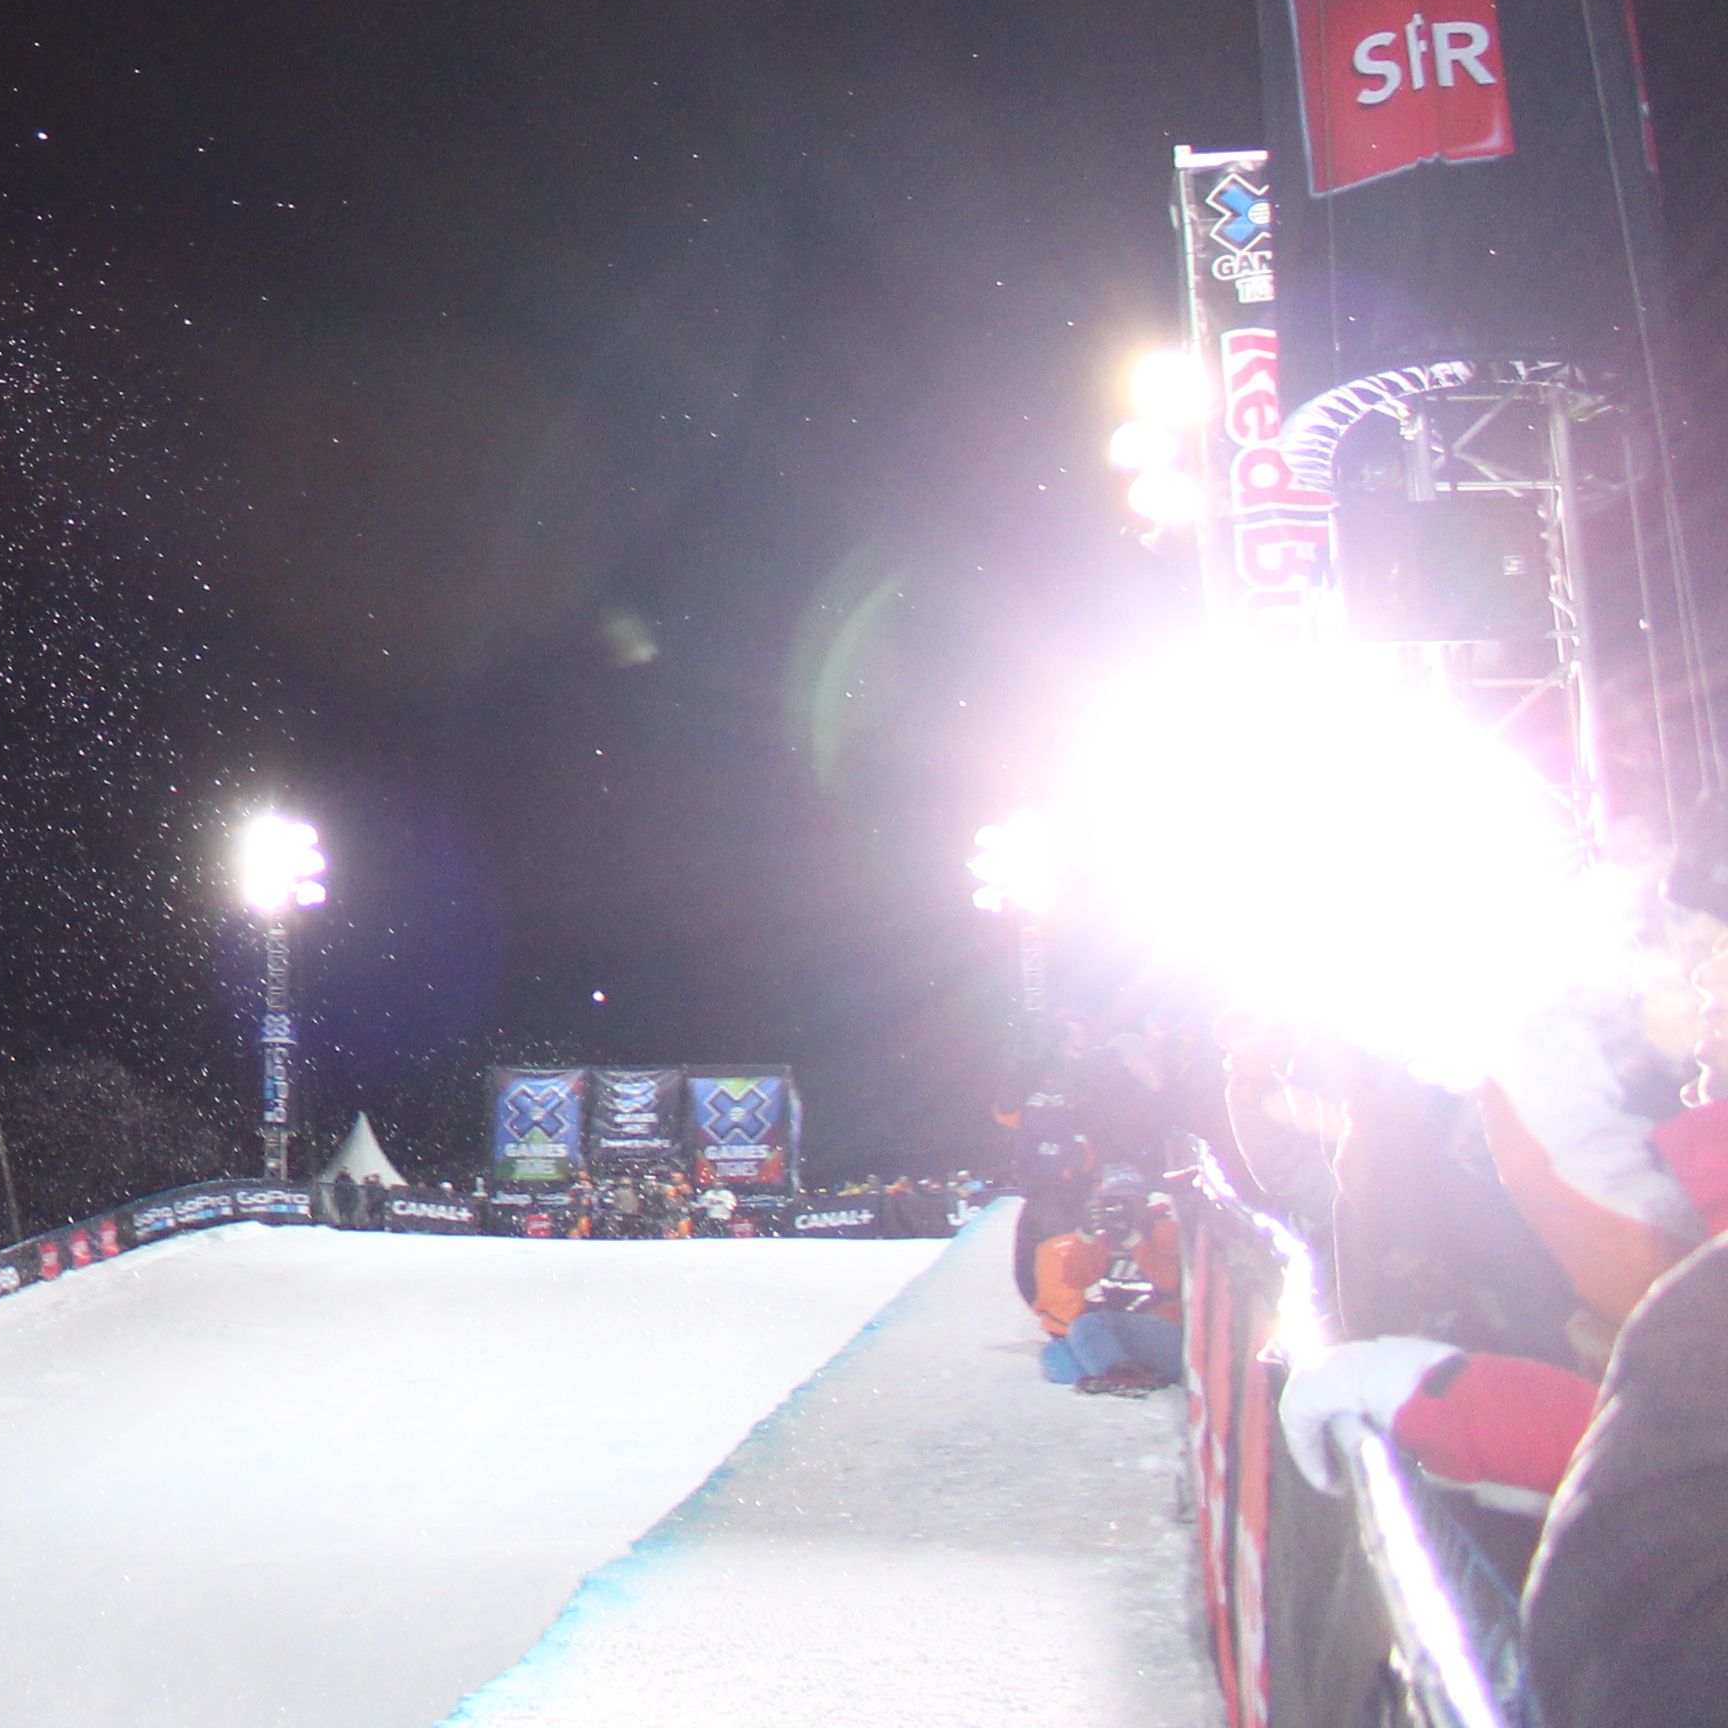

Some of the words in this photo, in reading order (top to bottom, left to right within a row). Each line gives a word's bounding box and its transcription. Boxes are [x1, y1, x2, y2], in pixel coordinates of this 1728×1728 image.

[1353, 13, 1496, 106] SFR
[236, 1190, 311, 1205] GoPro
[391, 1199, 475, 1221] CANAL+
[794, 1208, 875, 1230] CANAL+
